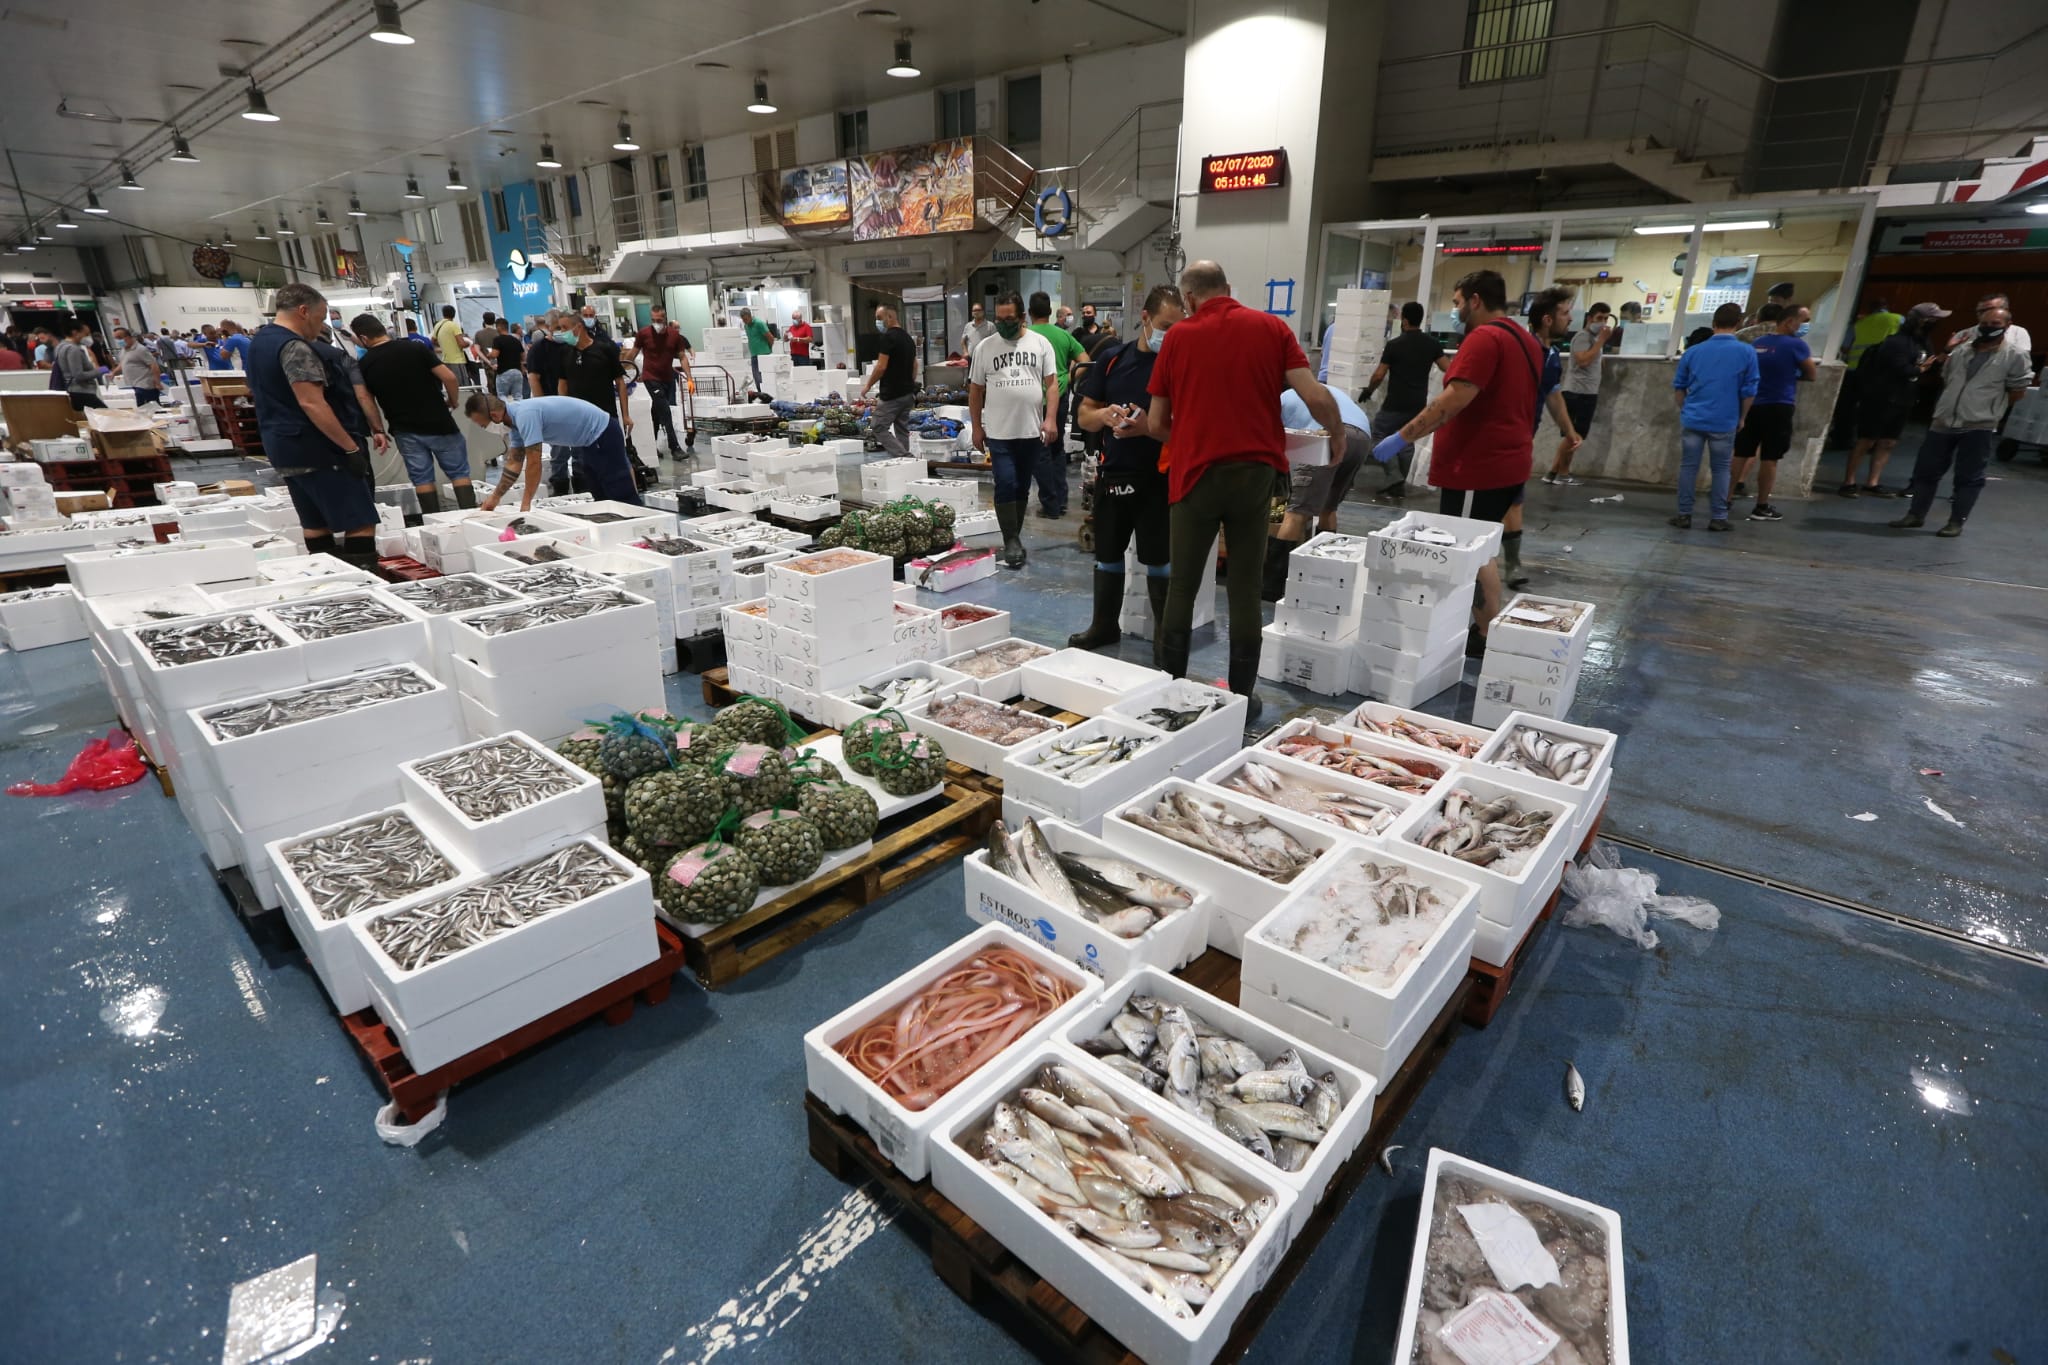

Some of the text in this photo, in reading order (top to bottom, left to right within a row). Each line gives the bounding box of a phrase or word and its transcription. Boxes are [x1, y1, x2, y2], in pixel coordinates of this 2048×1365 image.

[1209, 155, 1274, 173] 02/07/2020
[993, 351, 1037, 371] OXFORD
[979, 892, 1031, 929] ESTEROS
